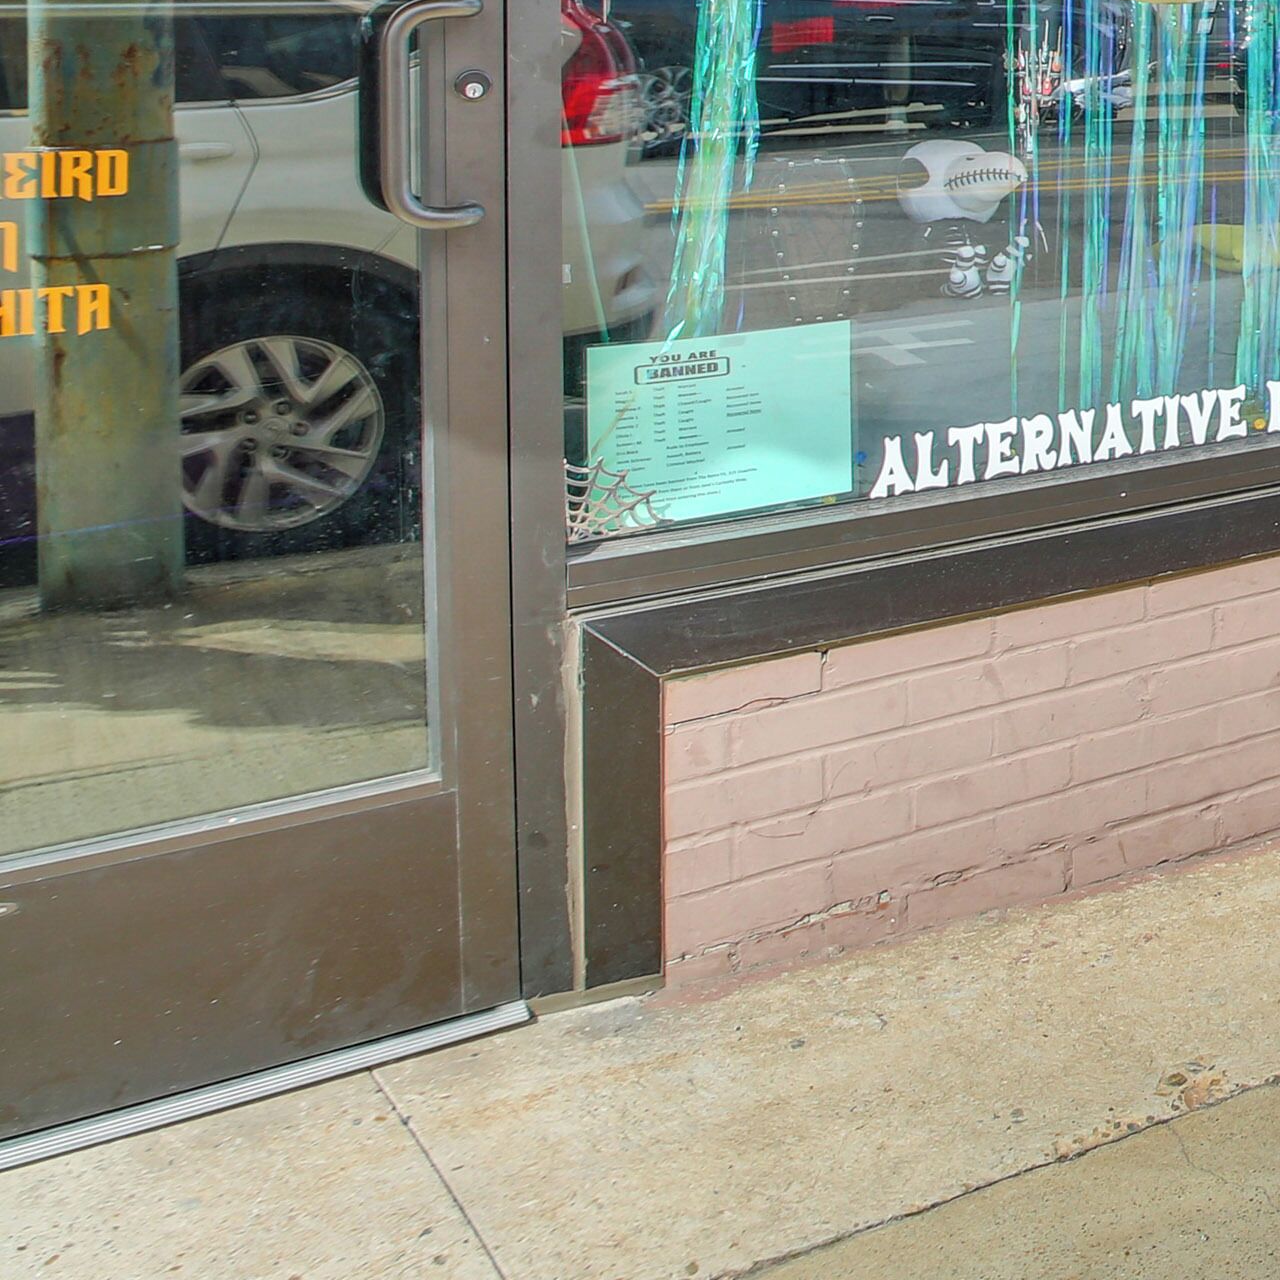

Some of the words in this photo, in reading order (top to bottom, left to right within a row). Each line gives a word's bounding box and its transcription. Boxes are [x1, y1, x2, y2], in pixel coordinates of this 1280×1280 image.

[0, 149, 129, 202] EIRD
[645, 361, 719, 380] BANNED
[649, 354, 681, 364] YOU
[688, 349, 717, 360] ARE
[869, 383, 1250, 500] ALTERNATIVE
